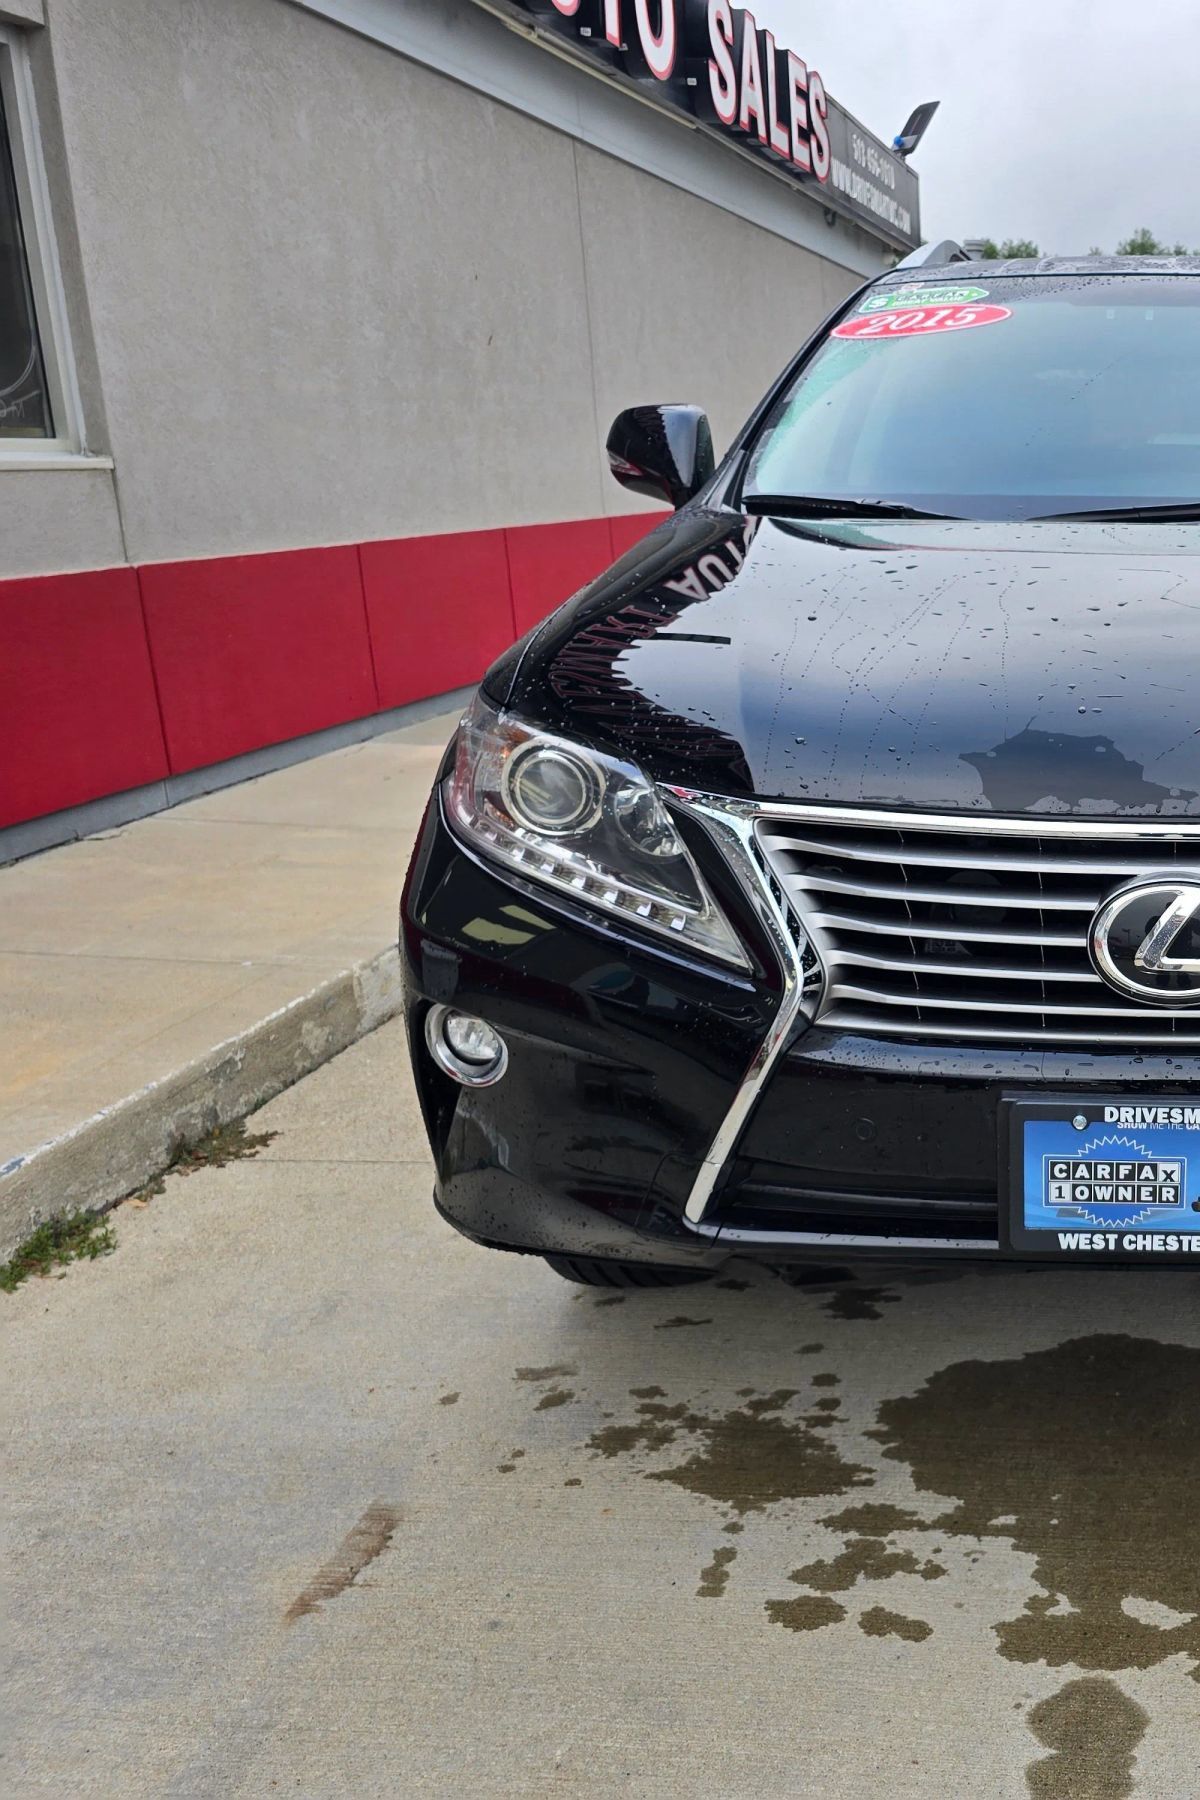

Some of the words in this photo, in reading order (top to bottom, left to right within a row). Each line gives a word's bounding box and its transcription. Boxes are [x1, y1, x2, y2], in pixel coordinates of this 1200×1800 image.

[707, 0, 831, 184] SALES
[857, 307, 987, 335] 2015
[1053, 1164, 1176, 1183] CARFAX
[1057, 1233, 1118, 1251] WEST
